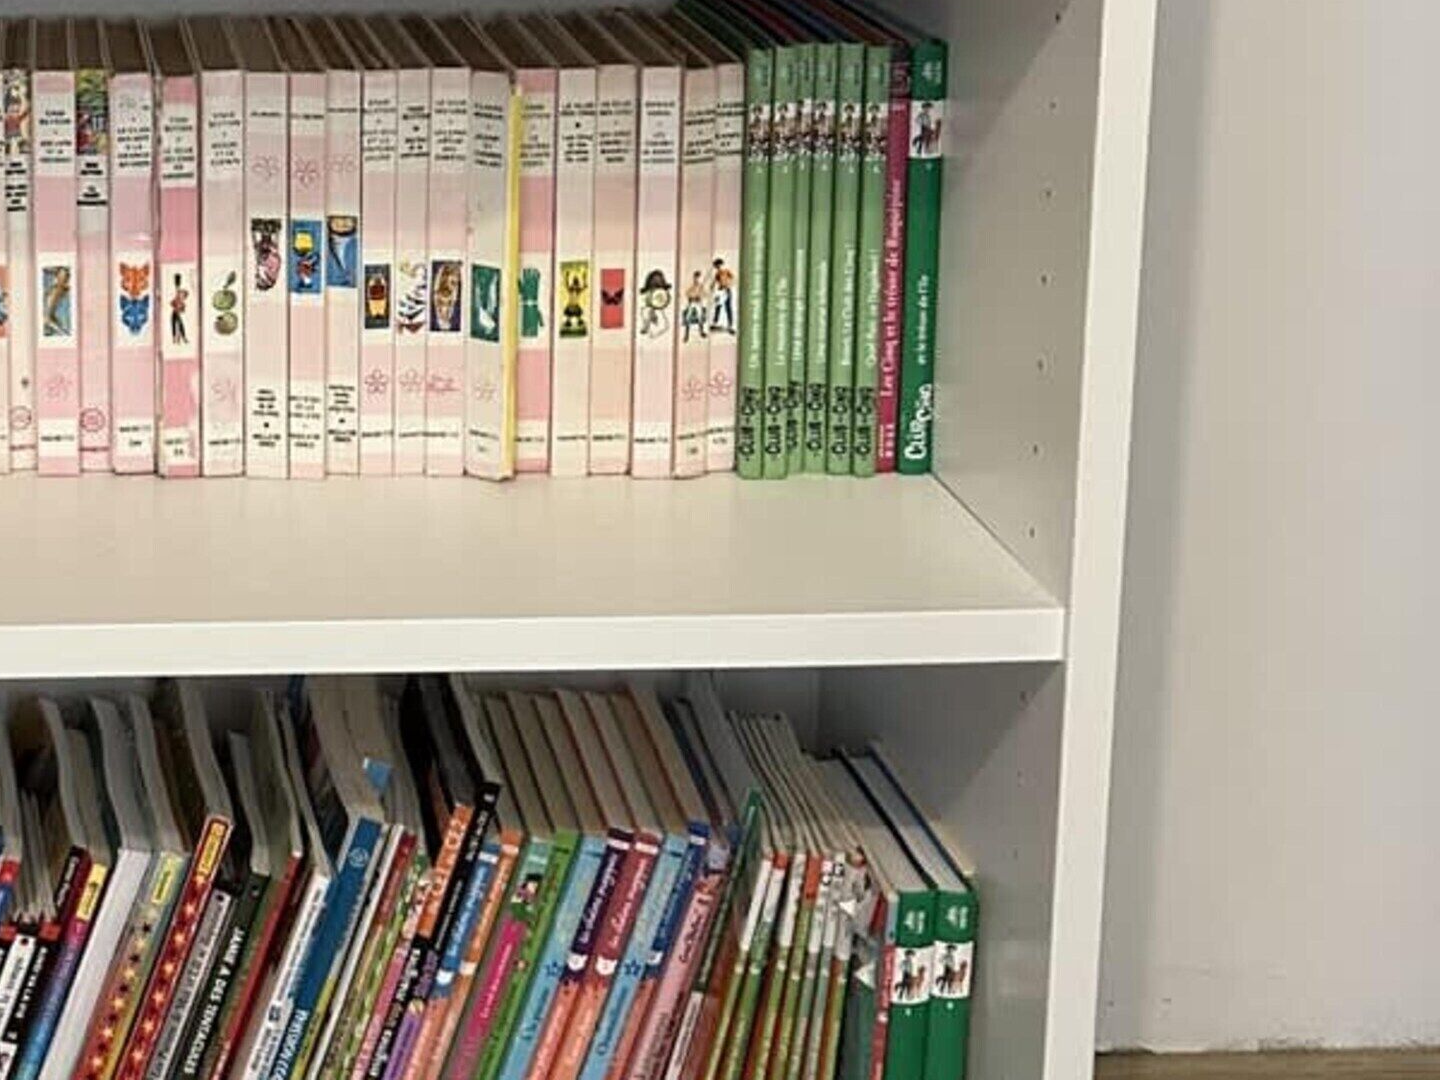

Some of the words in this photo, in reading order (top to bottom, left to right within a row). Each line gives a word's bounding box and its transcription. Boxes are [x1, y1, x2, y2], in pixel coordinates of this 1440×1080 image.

[887, 325, 897, 338] et
[882, 340, 898, 372] Cinq
[882, 375, 893, 396] Les
[218, 967, 230, 976] A
[208, 979, 227, 1001] DES
[183, 1004, 220, 1074] TENTACULES
